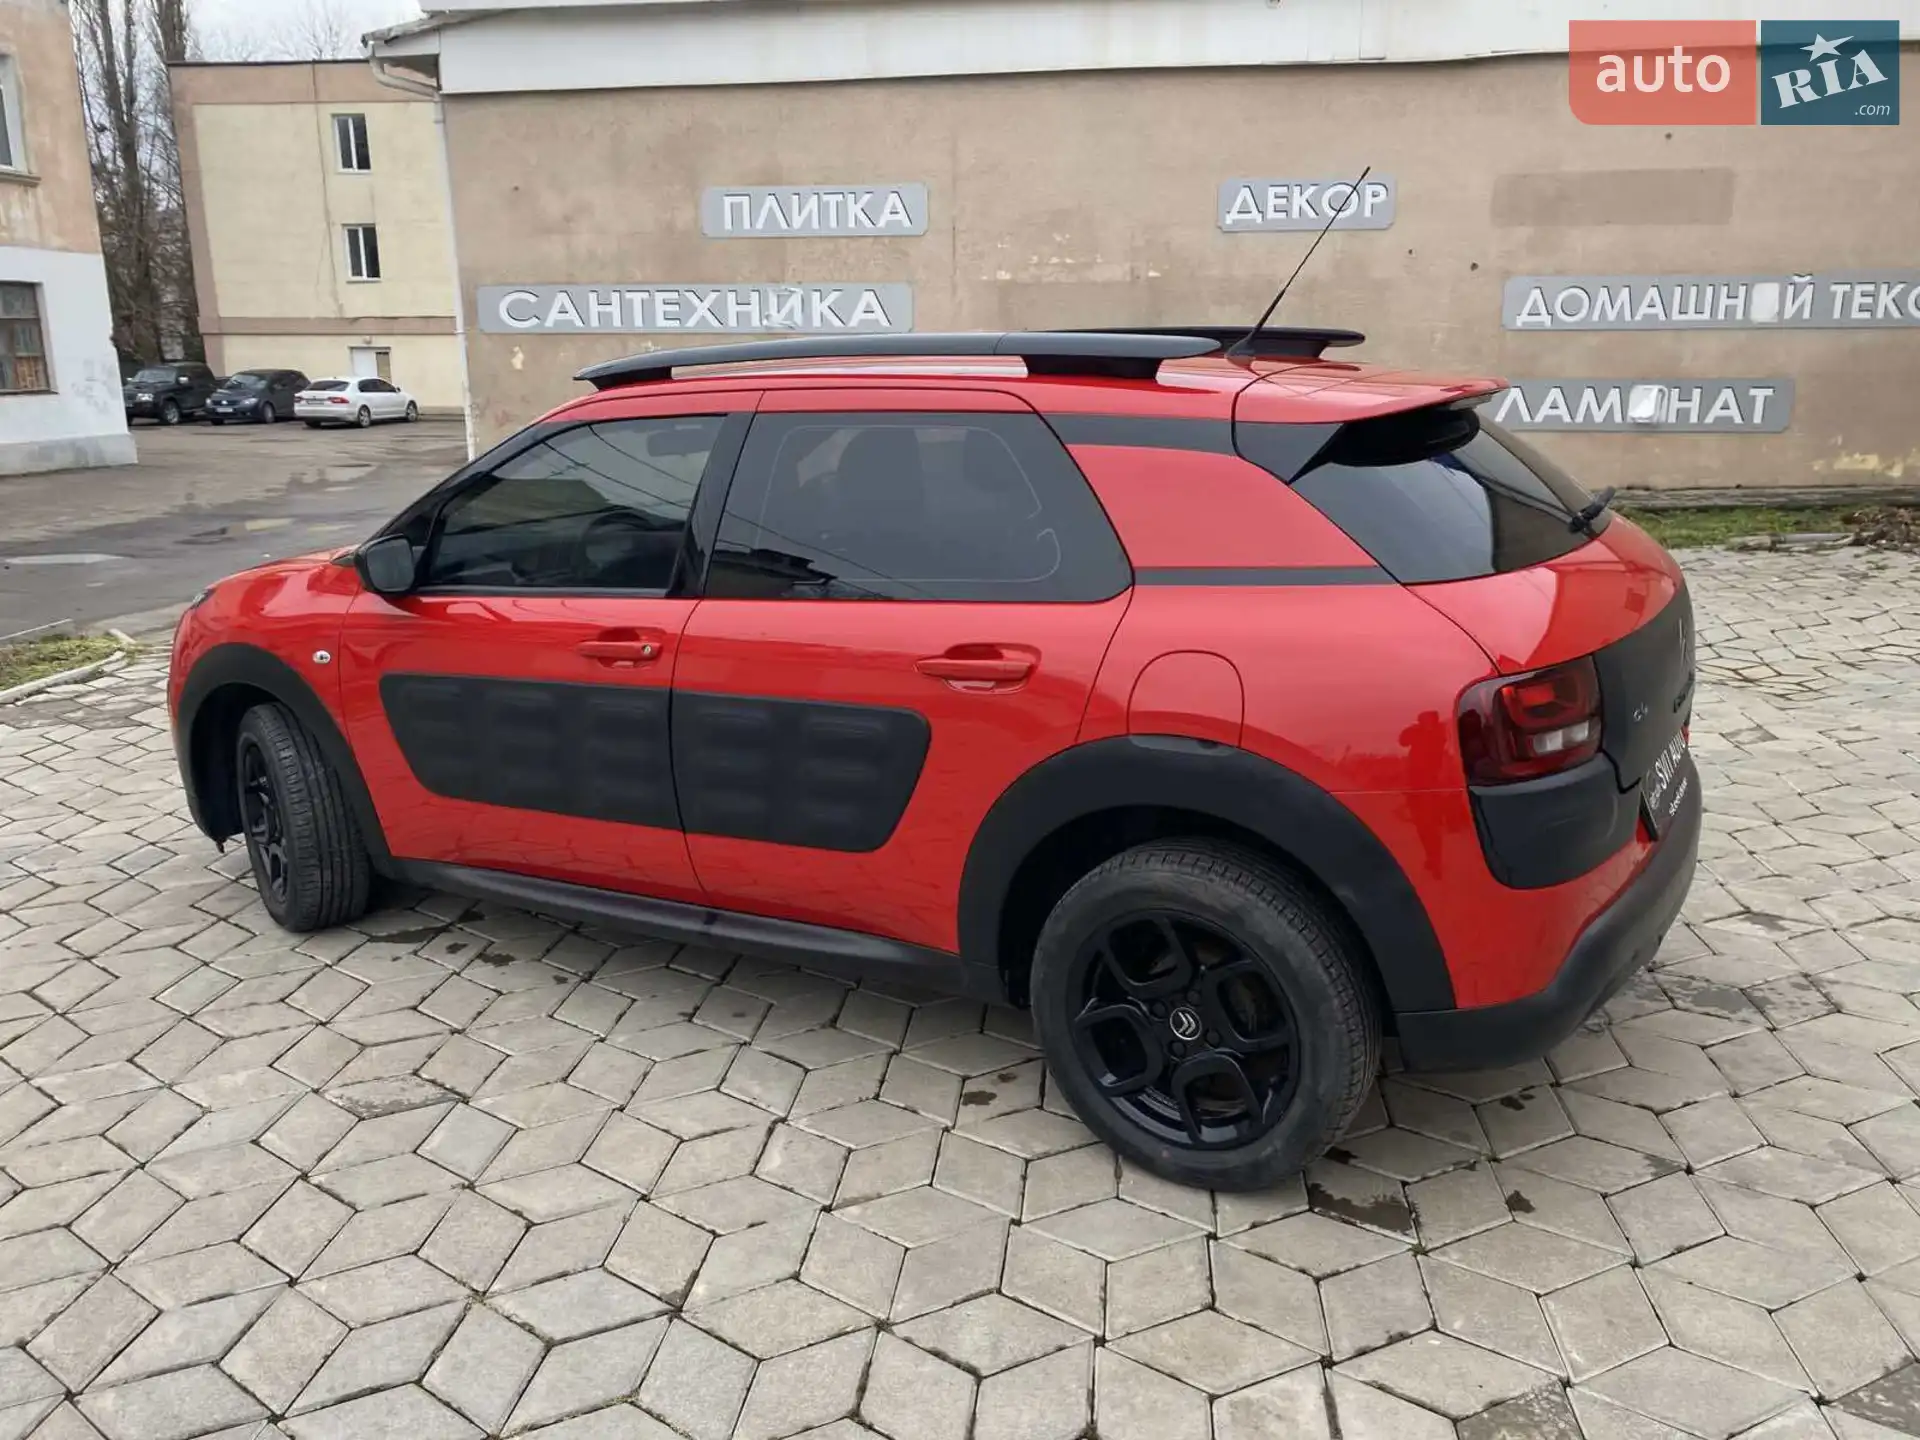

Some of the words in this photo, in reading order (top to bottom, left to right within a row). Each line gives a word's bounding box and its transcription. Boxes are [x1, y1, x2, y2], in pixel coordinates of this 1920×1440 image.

[722, 190, 913, 231] ПЛИТКА
[1224, 182, 1389, 224] ДЕКОР
[498, 288, 893, 330] САНТЕХНИКА
[1515, 273, 1816, 327] ДОМАШНЙ
[1494, 385, 1776, 424] ЛАМНАТ
